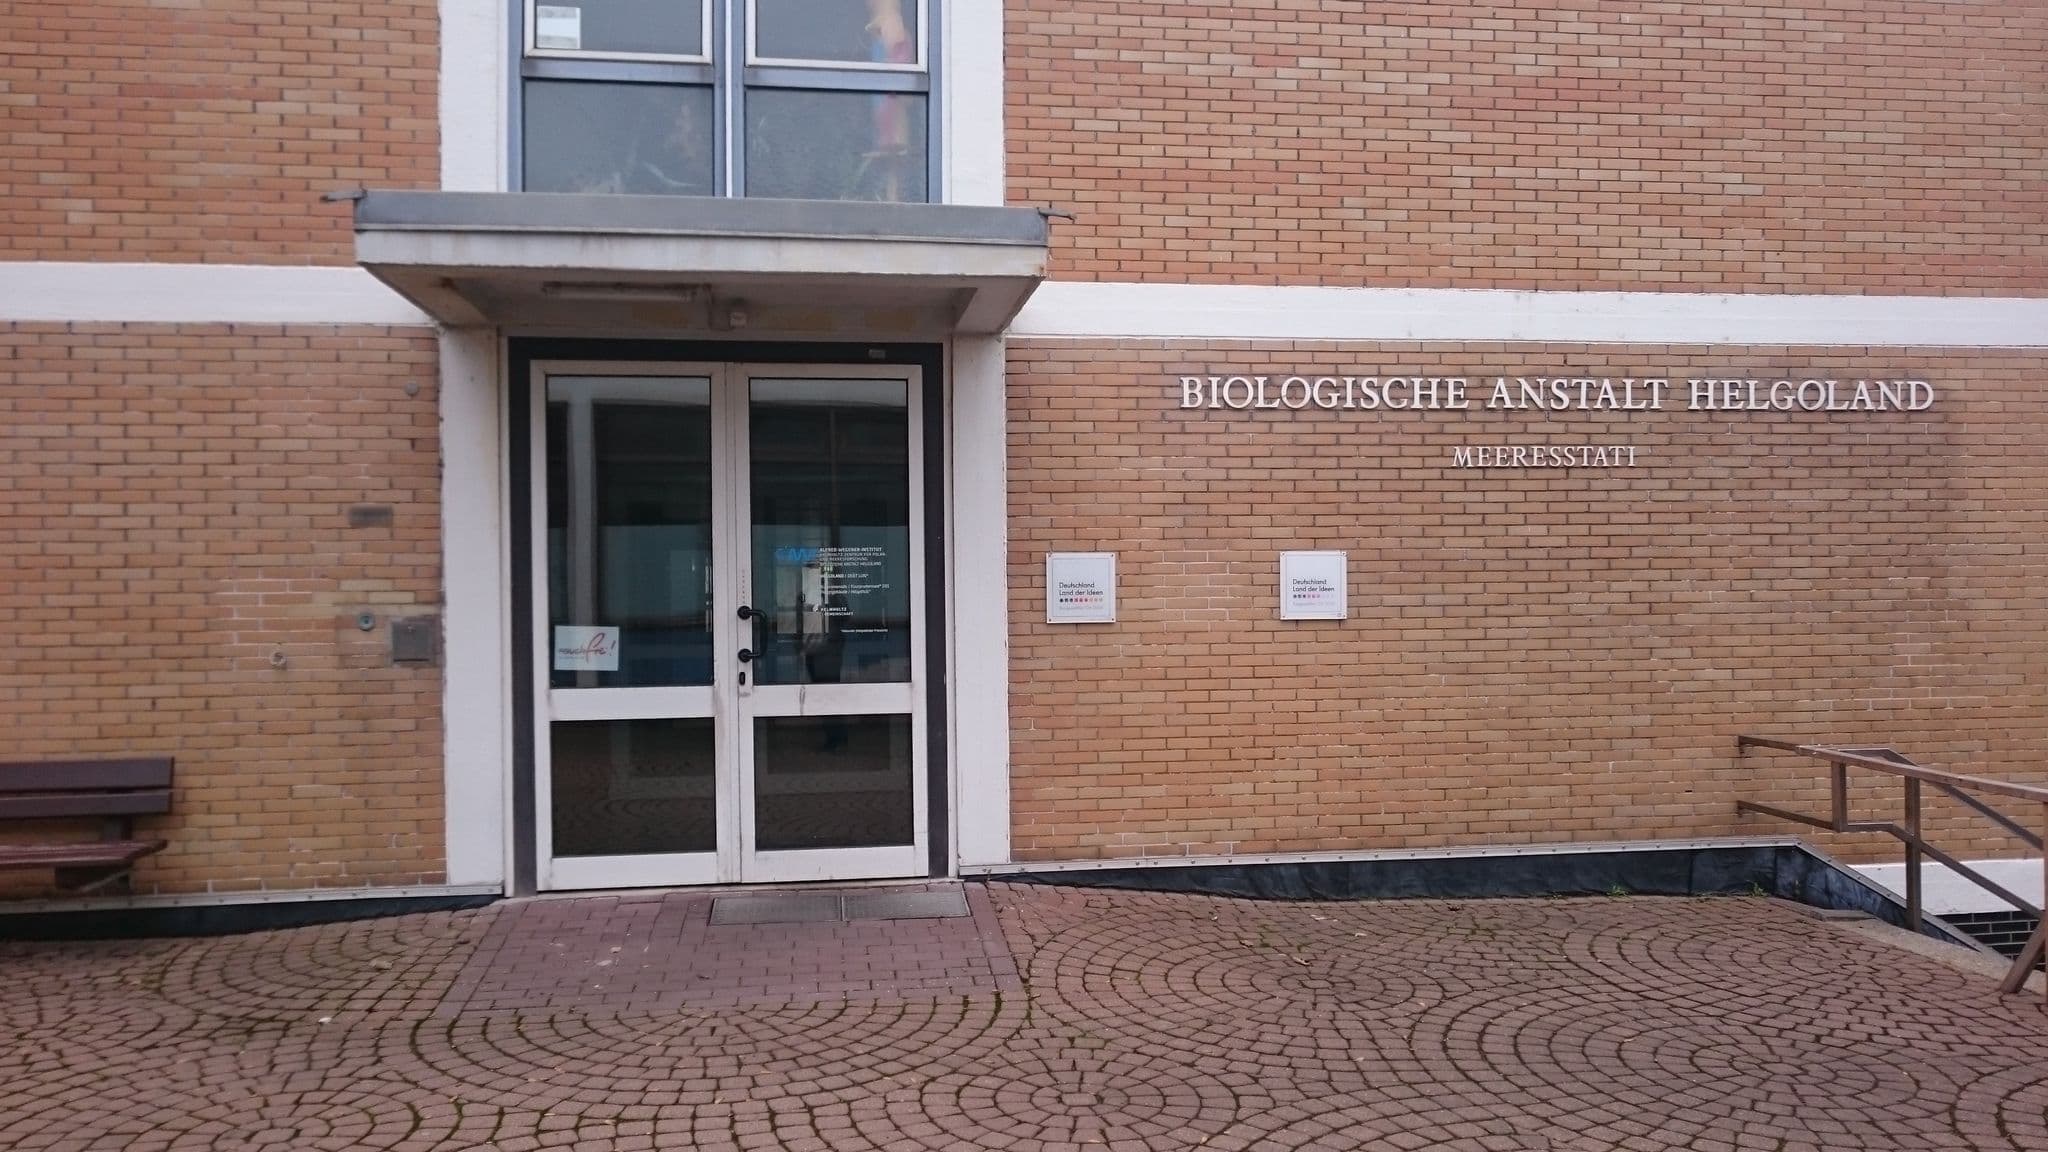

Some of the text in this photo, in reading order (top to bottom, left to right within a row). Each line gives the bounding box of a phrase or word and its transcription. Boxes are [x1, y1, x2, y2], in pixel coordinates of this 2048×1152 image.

[1180, 376, 1935, 411] BIOLOGISCHE ANSTALT HELGOLAND
[1452, 446, 1637, 468] MEERESSTATI
